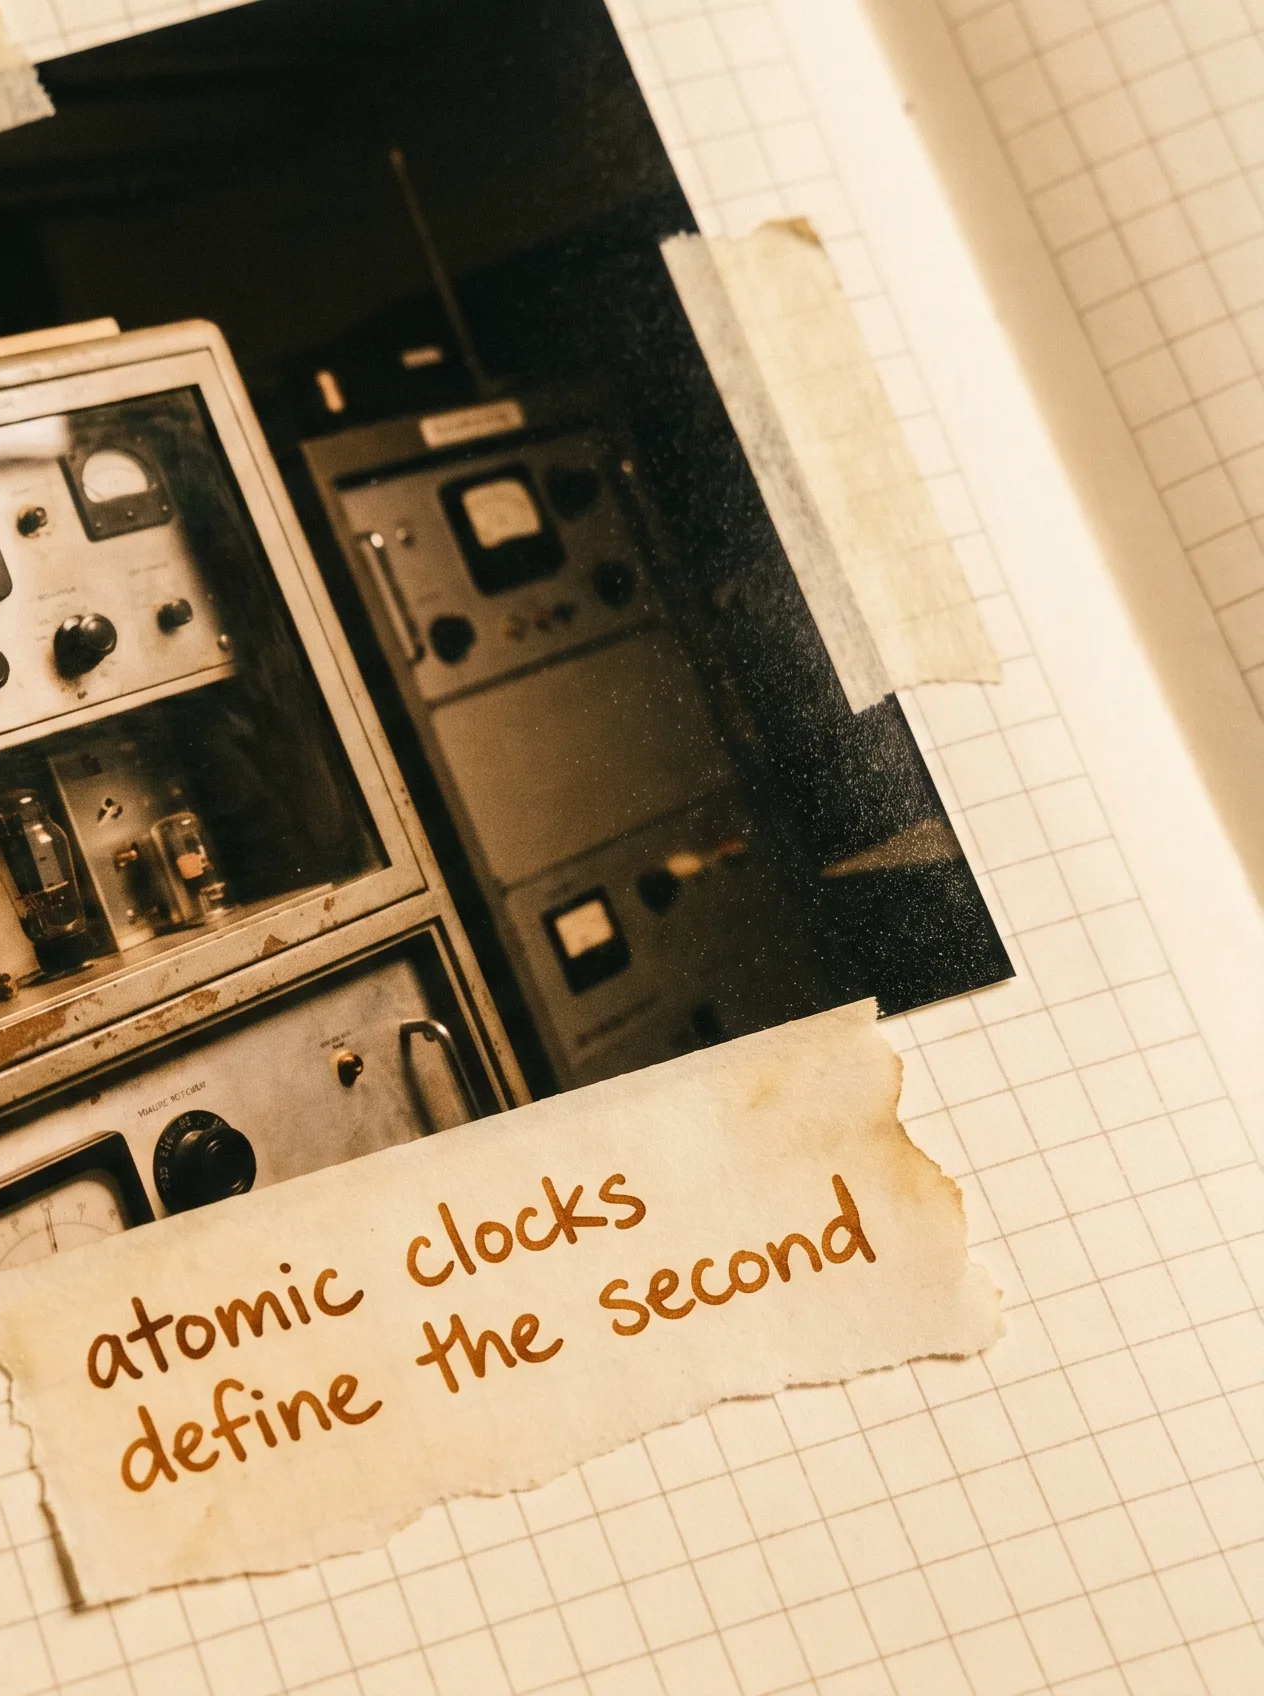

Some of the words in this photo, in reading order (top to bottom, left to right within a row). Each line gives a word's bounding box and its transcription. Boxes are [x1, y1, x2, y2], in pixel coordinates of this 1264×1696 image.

[86, 1262, 364, 1390] atomic
[406, 1173, 647, 1287] clocks
[120, 1374, 383, 1493] define
[415, 1312, 564, 1394] the
[598, 1173, 877, 1337] second
